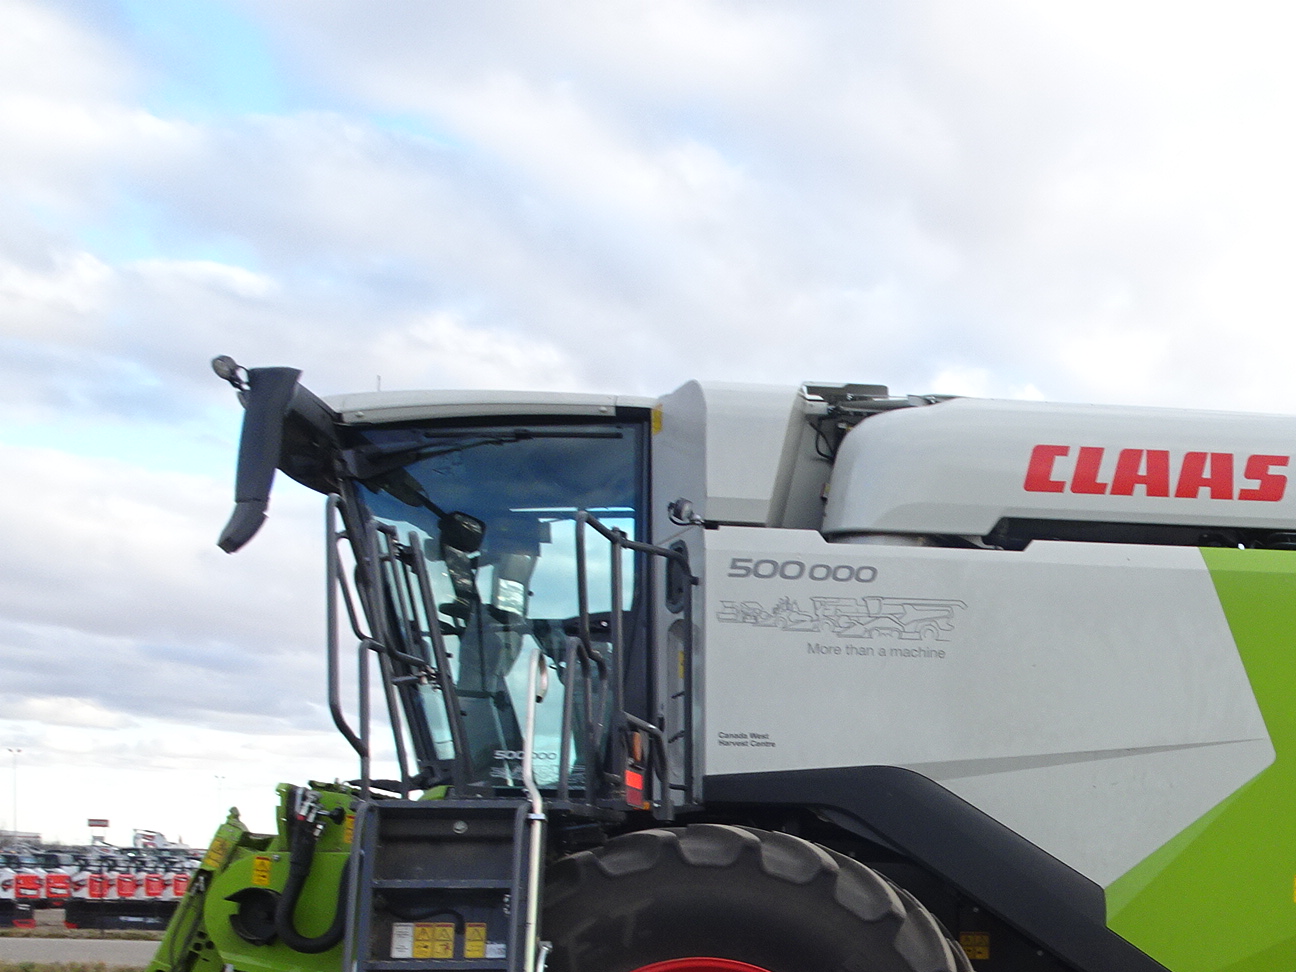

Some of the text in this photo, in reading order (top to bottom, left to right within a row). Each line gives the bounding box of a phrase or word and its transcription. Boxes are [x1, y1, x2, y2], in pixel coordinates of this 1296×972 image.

[1023, 444, 1290, 502] CLAAS
[728, 557, 805, 580] 500
[806, 642, 946, 660] More than a machine
[718, 731, 770, 740] Canada West
[718, 739, 776, 748] Harvest Centre
